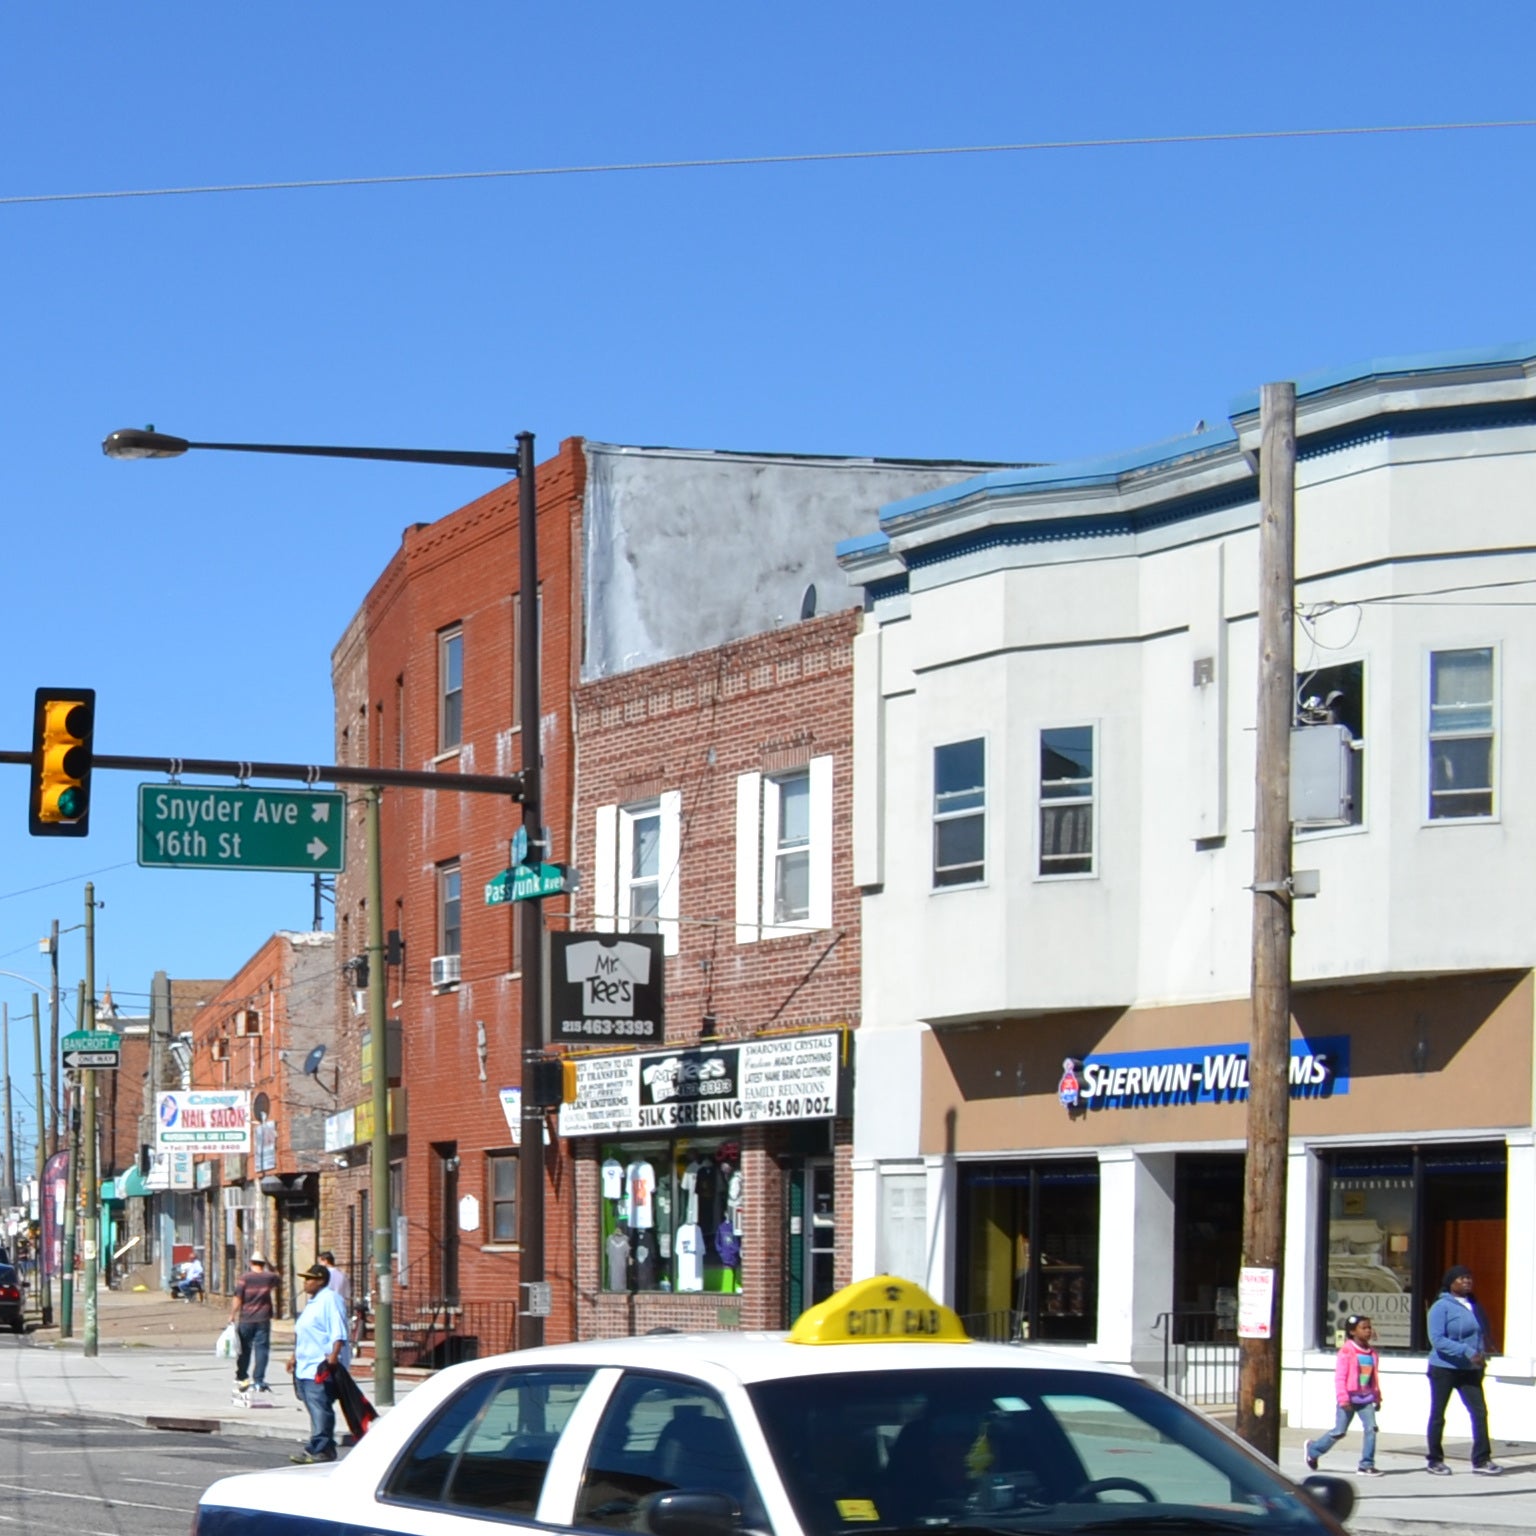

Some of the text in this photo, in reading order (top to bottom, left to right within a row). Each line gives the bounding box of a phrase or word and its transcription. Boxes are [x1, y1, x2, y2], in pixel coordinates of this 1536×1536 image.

[156, 794, 298, 825] Snyder Ave
[156, 832, 241, 858] 16th St
[544, 878, 560, 891] Ave
[595, 953, 619, 974] Mr.
[585, 975, 631, 1005] Tee's
[64, 1038, 109, 1050] BANCROFT
[746, 1038, 832, 1056] SWAROVSKI CRYSTALS
[774, 1056, 794, 1066] MADE
[795, 1052, 832, 1064] CLOTHING
[745, 1066, 831, 1084] LATEST NAME BRAND CLOTHING
[1080, 1054, 1328, 1097] SHERWIN-WILMS
[745, 1082, 824, 1099] FAMILY REUNIONS
[181, 1108, 245, 1128] NAIL SALON
[638, 1101, 743, 1127] SILK SCREENING
[1350, 1295, 1410, 1313] COLOR
[848, 1309, 940, 1335] CITY CAB
